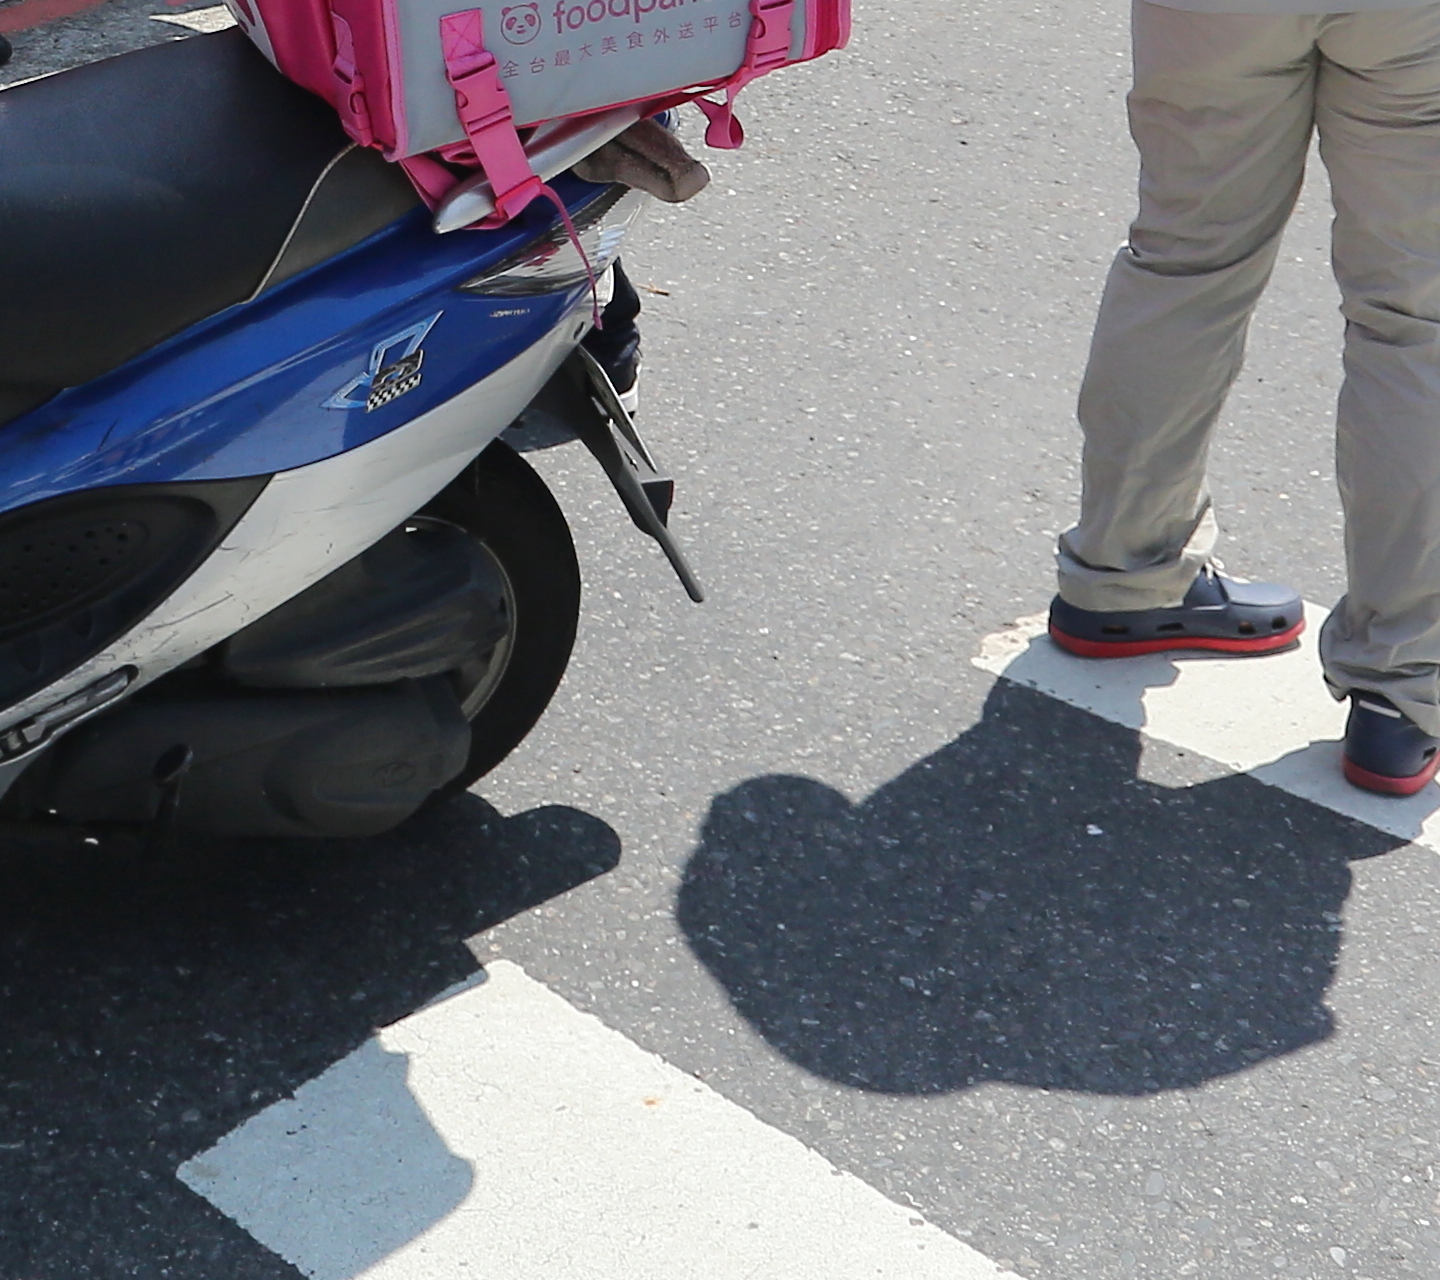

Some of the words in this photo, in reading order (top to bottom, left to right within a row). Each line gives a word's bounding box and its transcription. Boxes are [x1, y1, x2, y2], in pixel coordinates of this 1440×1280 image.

[502, 12, 742, 79] 全台最大美食外送平台
